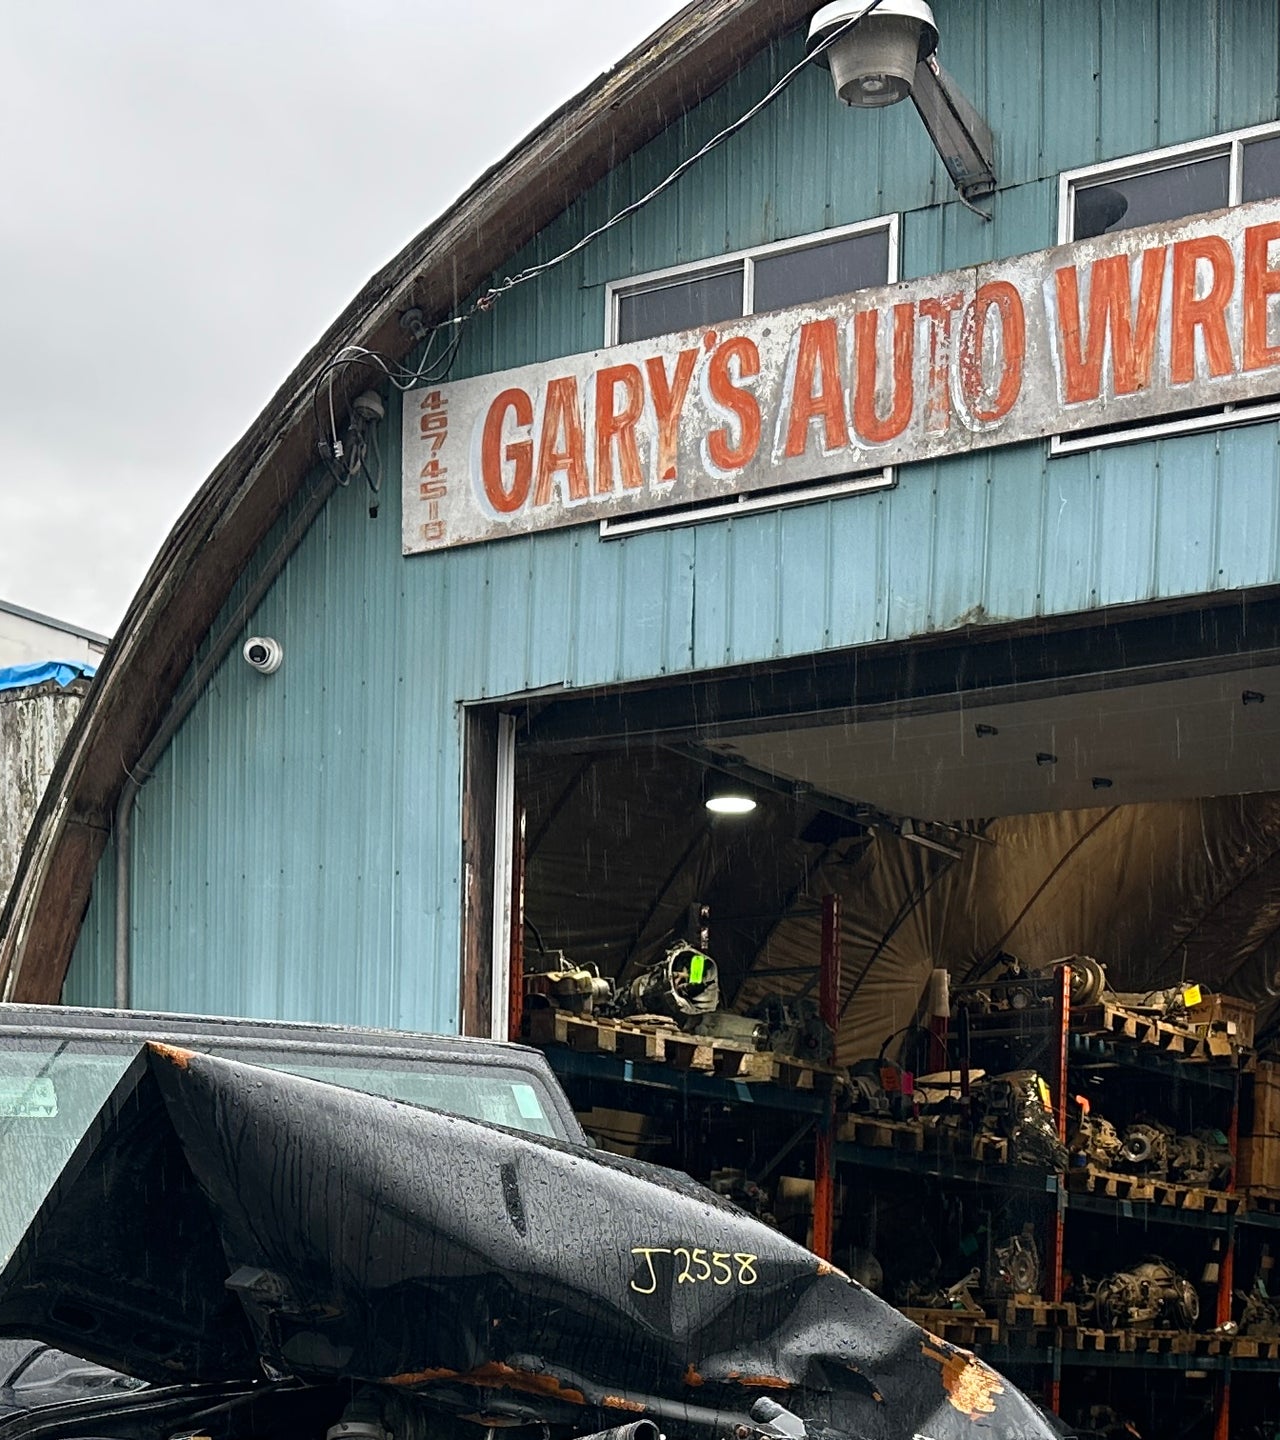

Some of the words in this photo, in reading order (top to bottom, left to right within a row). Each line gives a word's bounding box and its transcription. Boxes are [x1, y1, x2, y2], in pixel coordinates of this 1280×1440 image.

[480, 331, 762, 514] GARY'S
[783, 279, 1025, 459] AUTO
[630, 1247, 758, 1294] J2558
